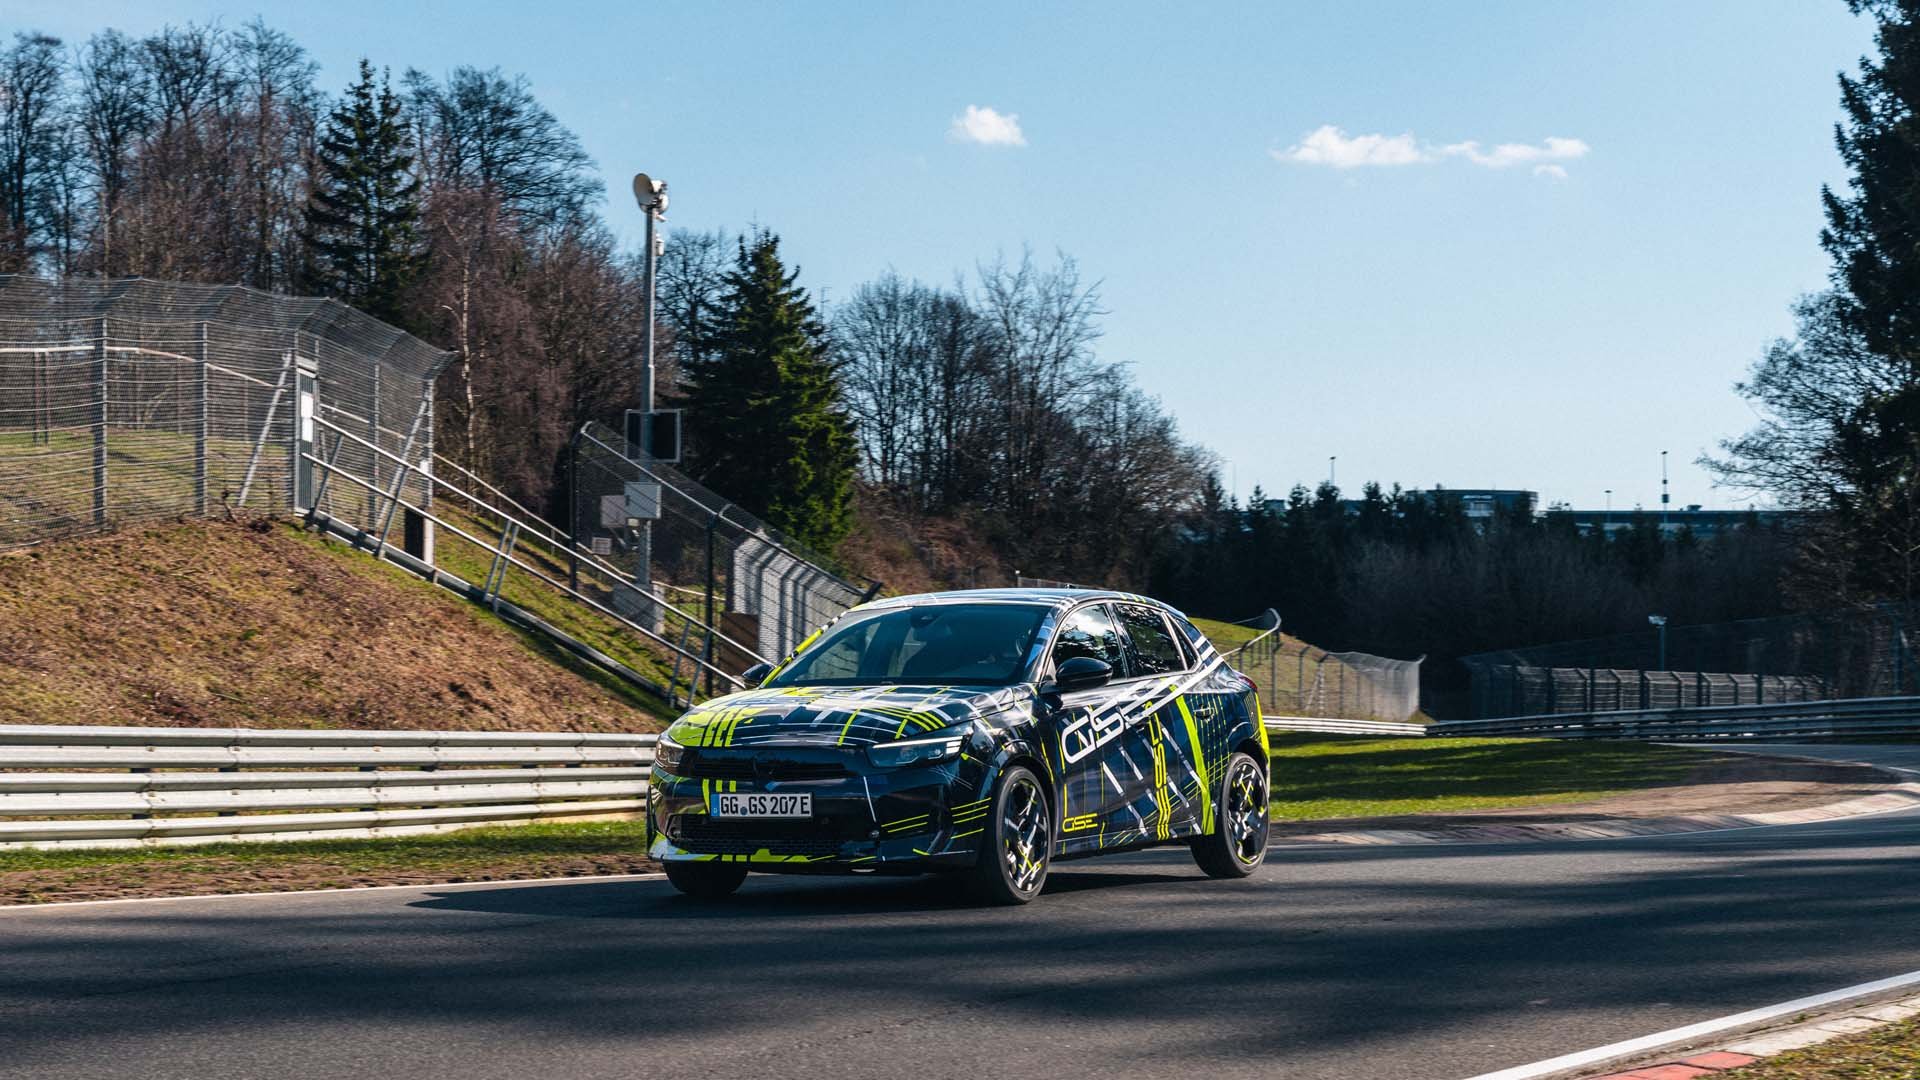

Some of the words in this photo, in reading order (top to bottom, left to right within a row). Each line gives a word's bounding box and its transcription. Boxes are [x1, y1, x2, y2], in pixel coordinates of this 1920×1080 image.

[721, 796, 738, 815] GG
[748, 796, 767, 815] GS
[1063, 813, 1098, 832] GSE
